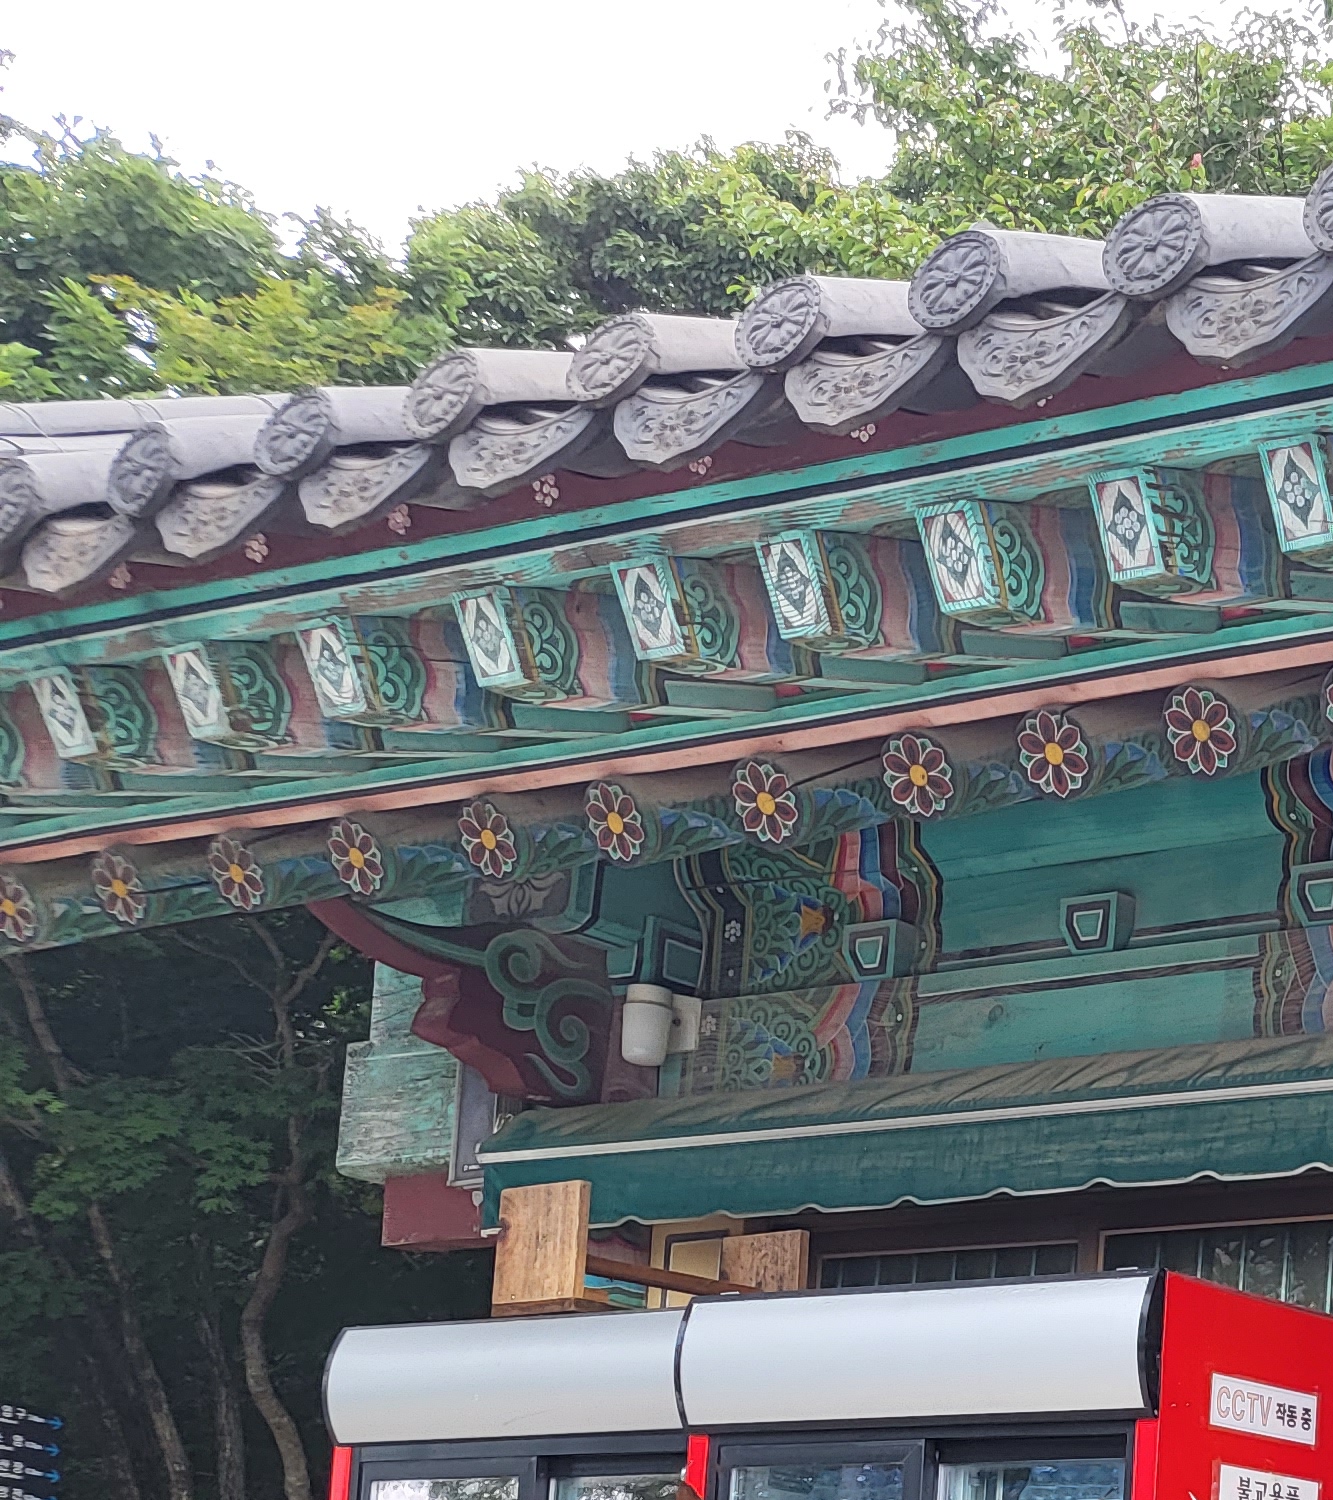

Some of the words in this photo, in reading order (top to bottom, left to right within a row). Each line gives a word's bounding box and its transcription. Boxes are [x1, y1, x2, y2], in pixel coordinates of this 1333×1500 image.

[1216, 1385, 1273, 1427] CCTV
[1275, 1402, 1298, 1428] 작동
[1300, 1406, 1312, 1431] 중
